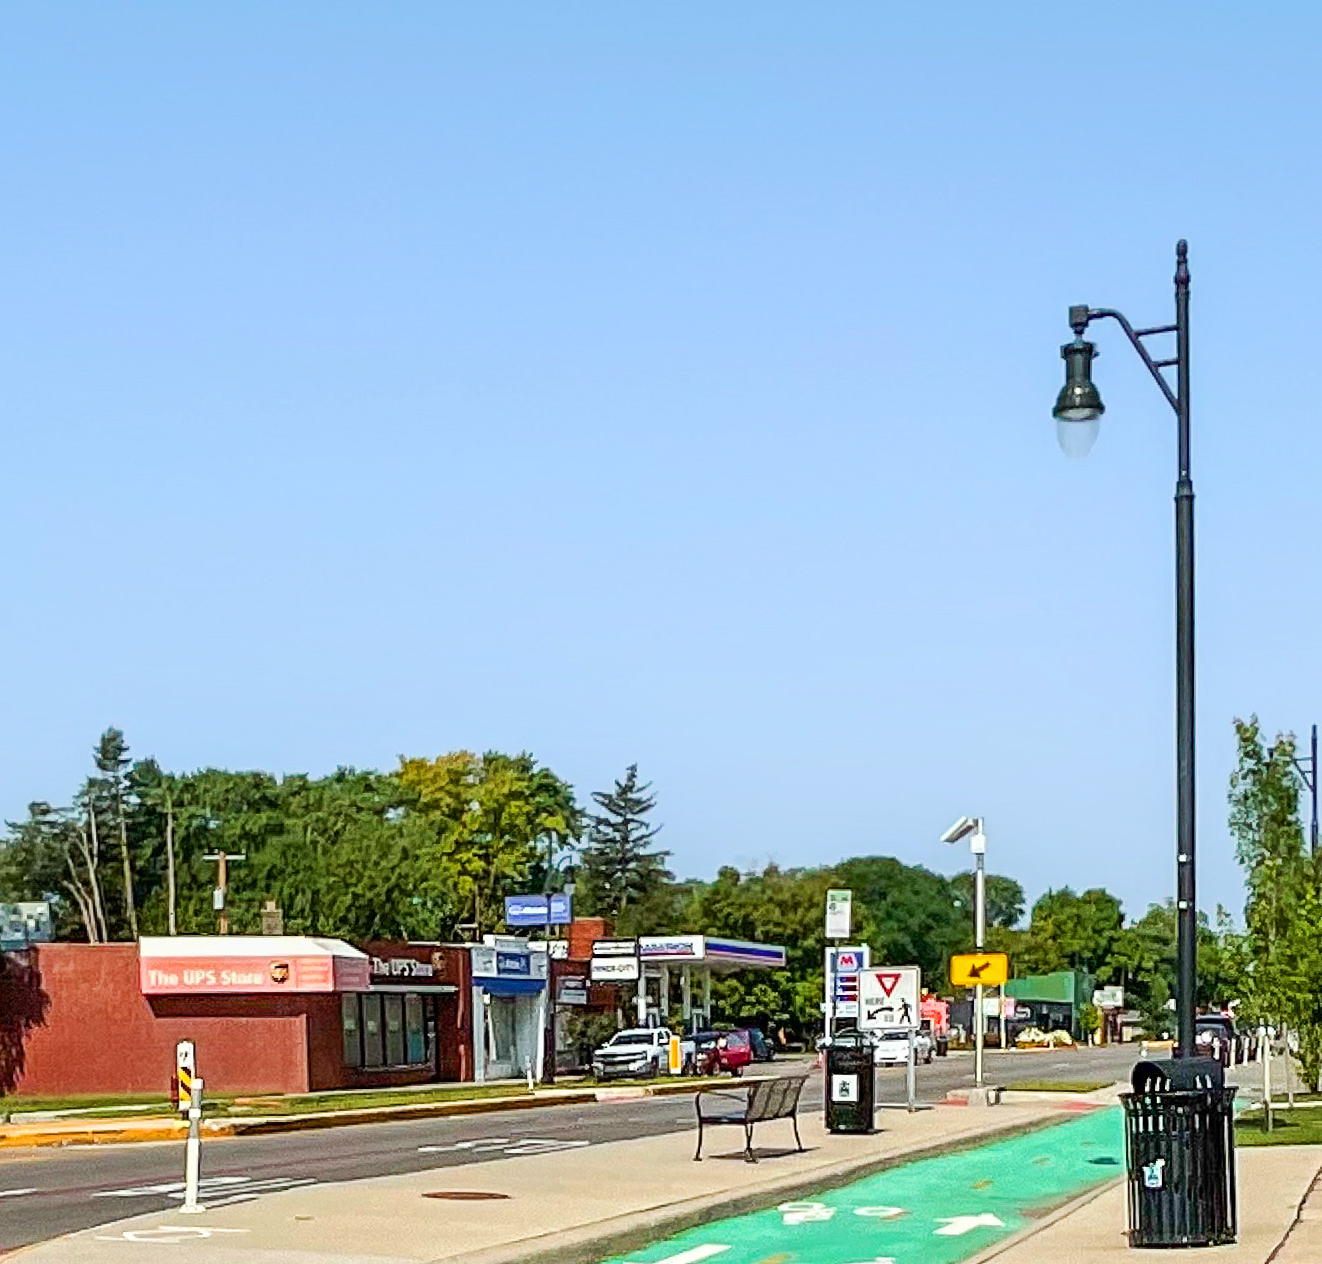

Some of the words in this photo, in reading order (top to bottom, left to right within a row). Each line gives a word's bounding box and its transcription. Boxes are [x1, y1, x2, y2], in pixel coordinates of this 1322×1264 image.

[148, 970, 179, 987] The
[182, 970, 217, 986] UPS
[220, 969, 263, 986] Store
